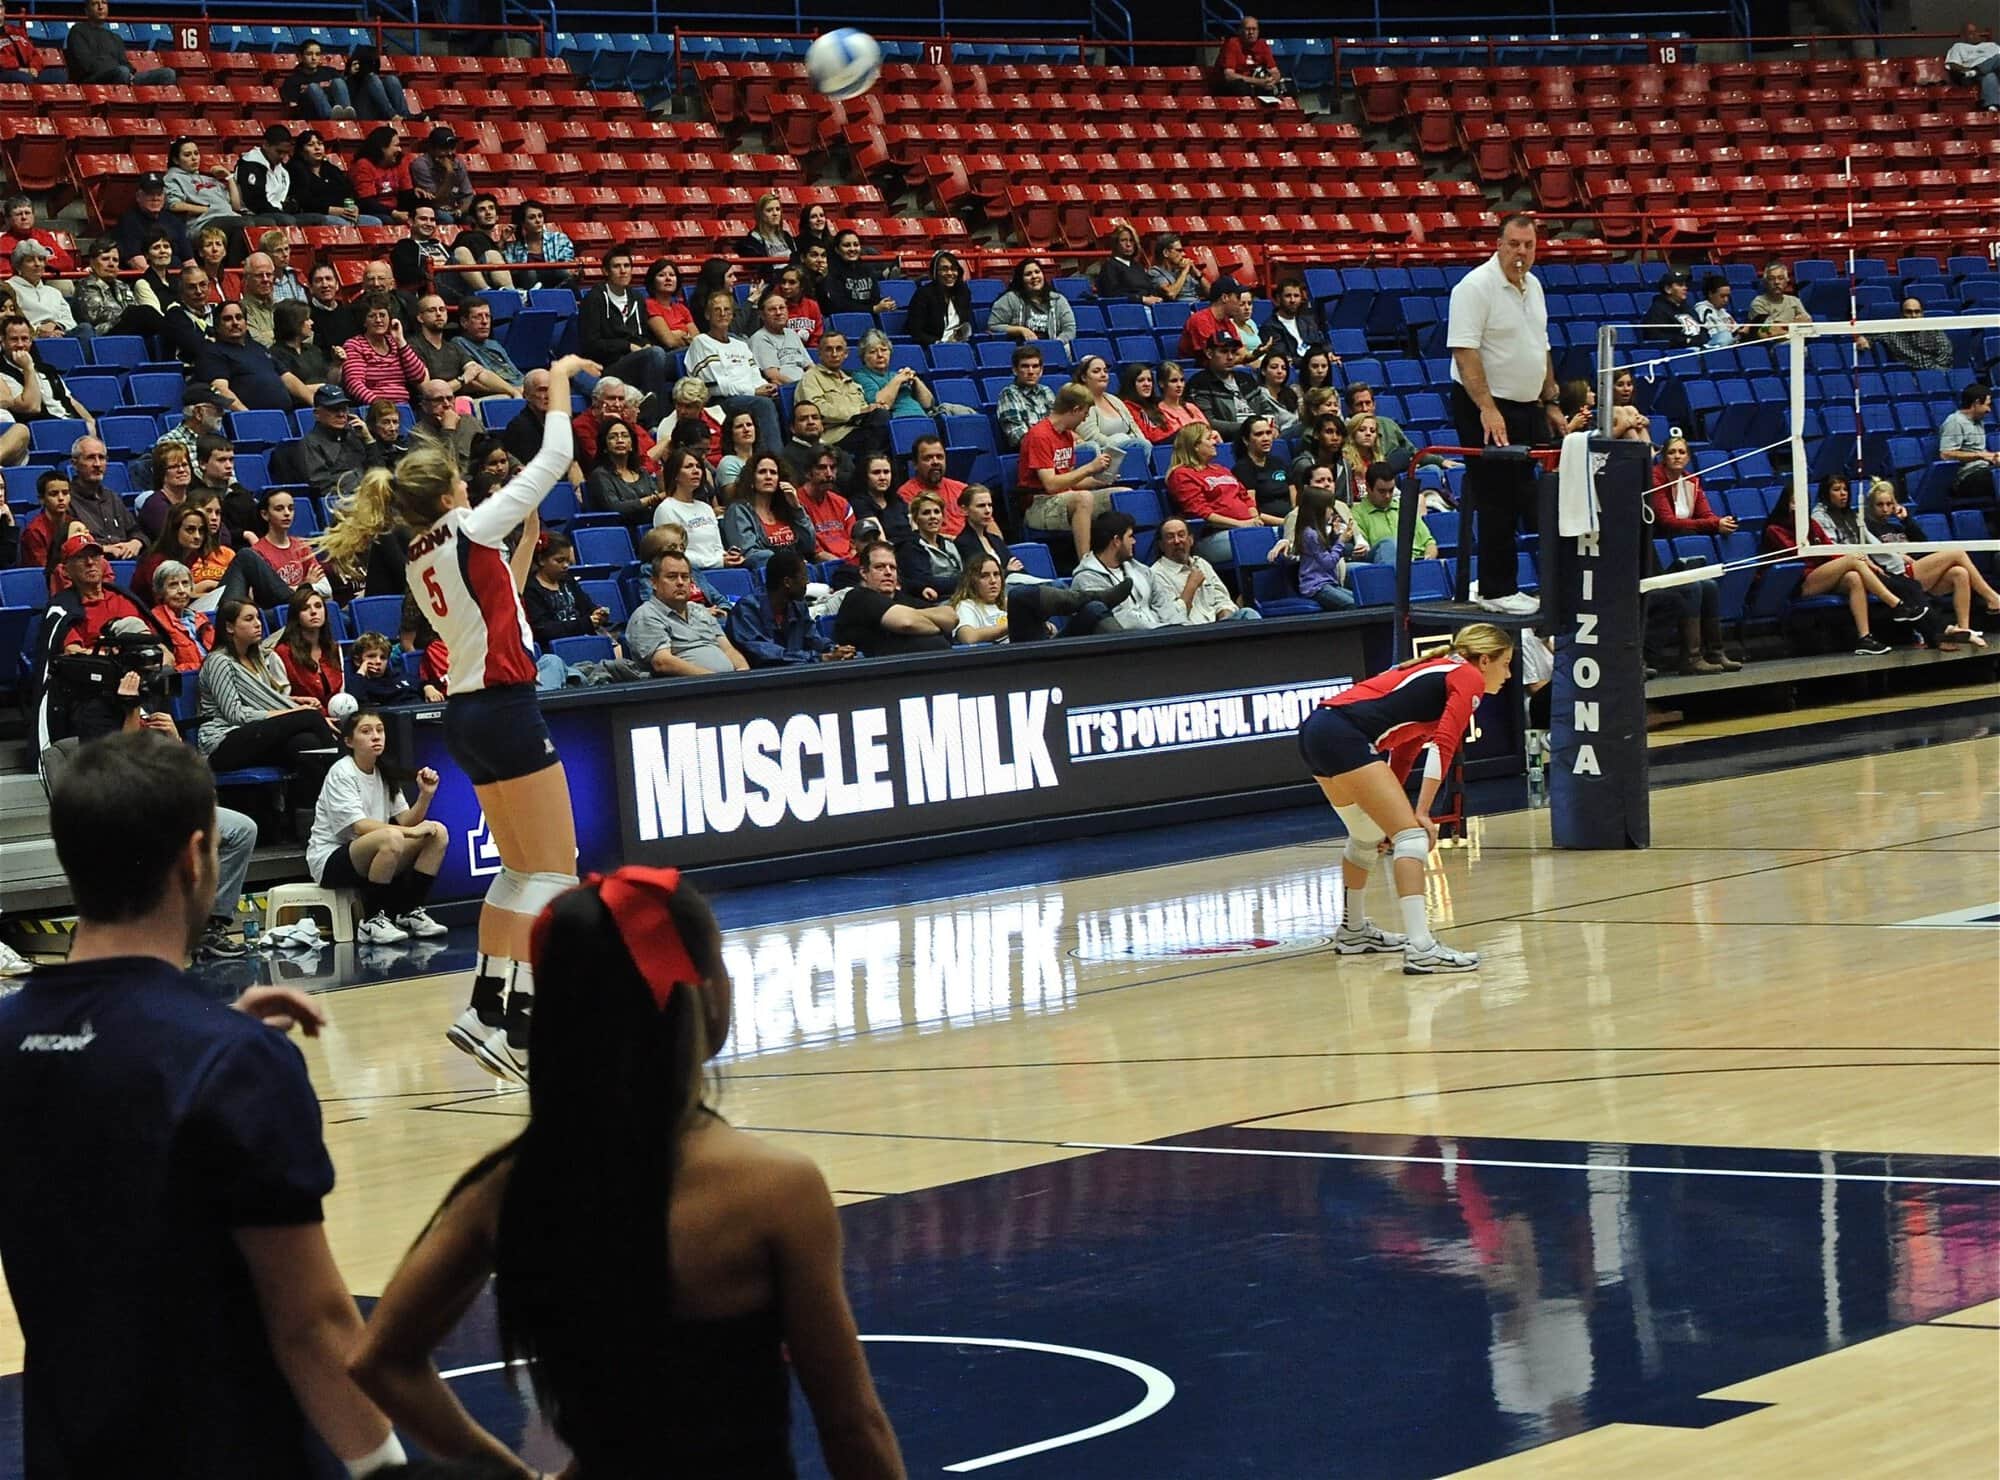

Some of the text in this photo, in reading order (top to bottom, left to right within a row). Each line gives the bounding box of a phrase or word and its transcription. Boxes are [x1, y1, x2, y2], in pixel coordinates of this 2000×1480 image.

[181, 28, 198, 49] 16
[930, 45, 943, 65] 17
[1660, 47, 1677, 64] 18
[407, 523, 453, 565] ZONA
[422, 566, 449, 617] 5
[1572, 527, 1602, 776] RIZONA
[1067, 683, 1354, 755] IT'S POWERFUL PROT
[631, 689, 1060, 841] MUSCLE MILK
